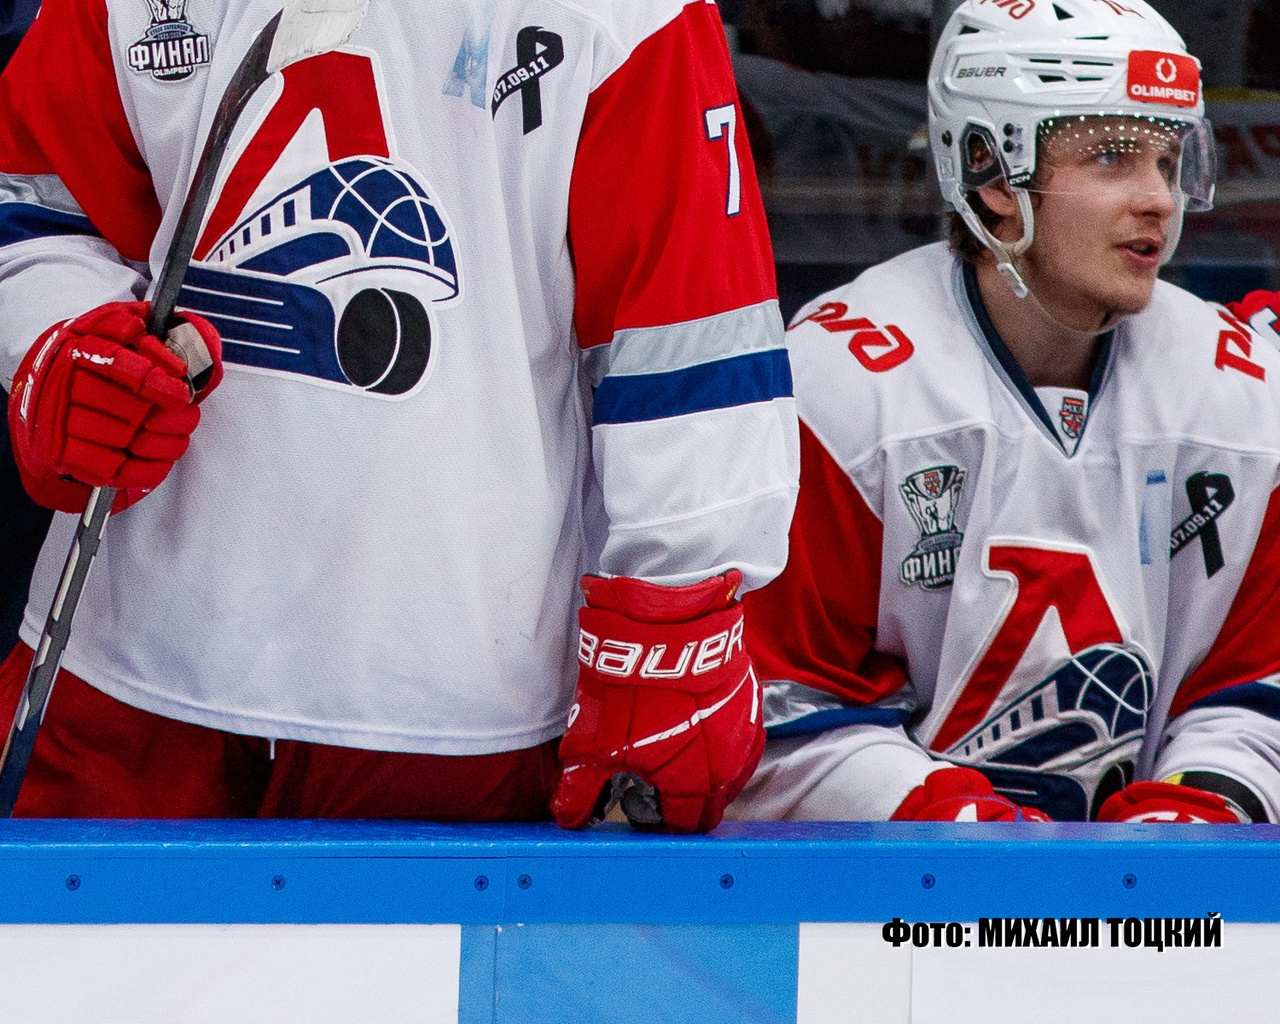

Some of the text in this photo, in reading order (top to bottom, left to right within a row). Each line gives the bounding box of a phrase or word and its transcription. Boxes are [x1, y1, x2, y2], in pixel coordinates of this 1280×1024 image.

[129, 36, 209, 70] ФИНАЛ
[493, 55, 550, 103] 07.09.11
[956, 66, 1007, 78] BAUER
[1131, 84, 1196, 102] OLIMPBET
[704, 102, 742, 216] 7
[902, 548, 961, 583] ФИН
[578, 614, 745, 679] BAUER
